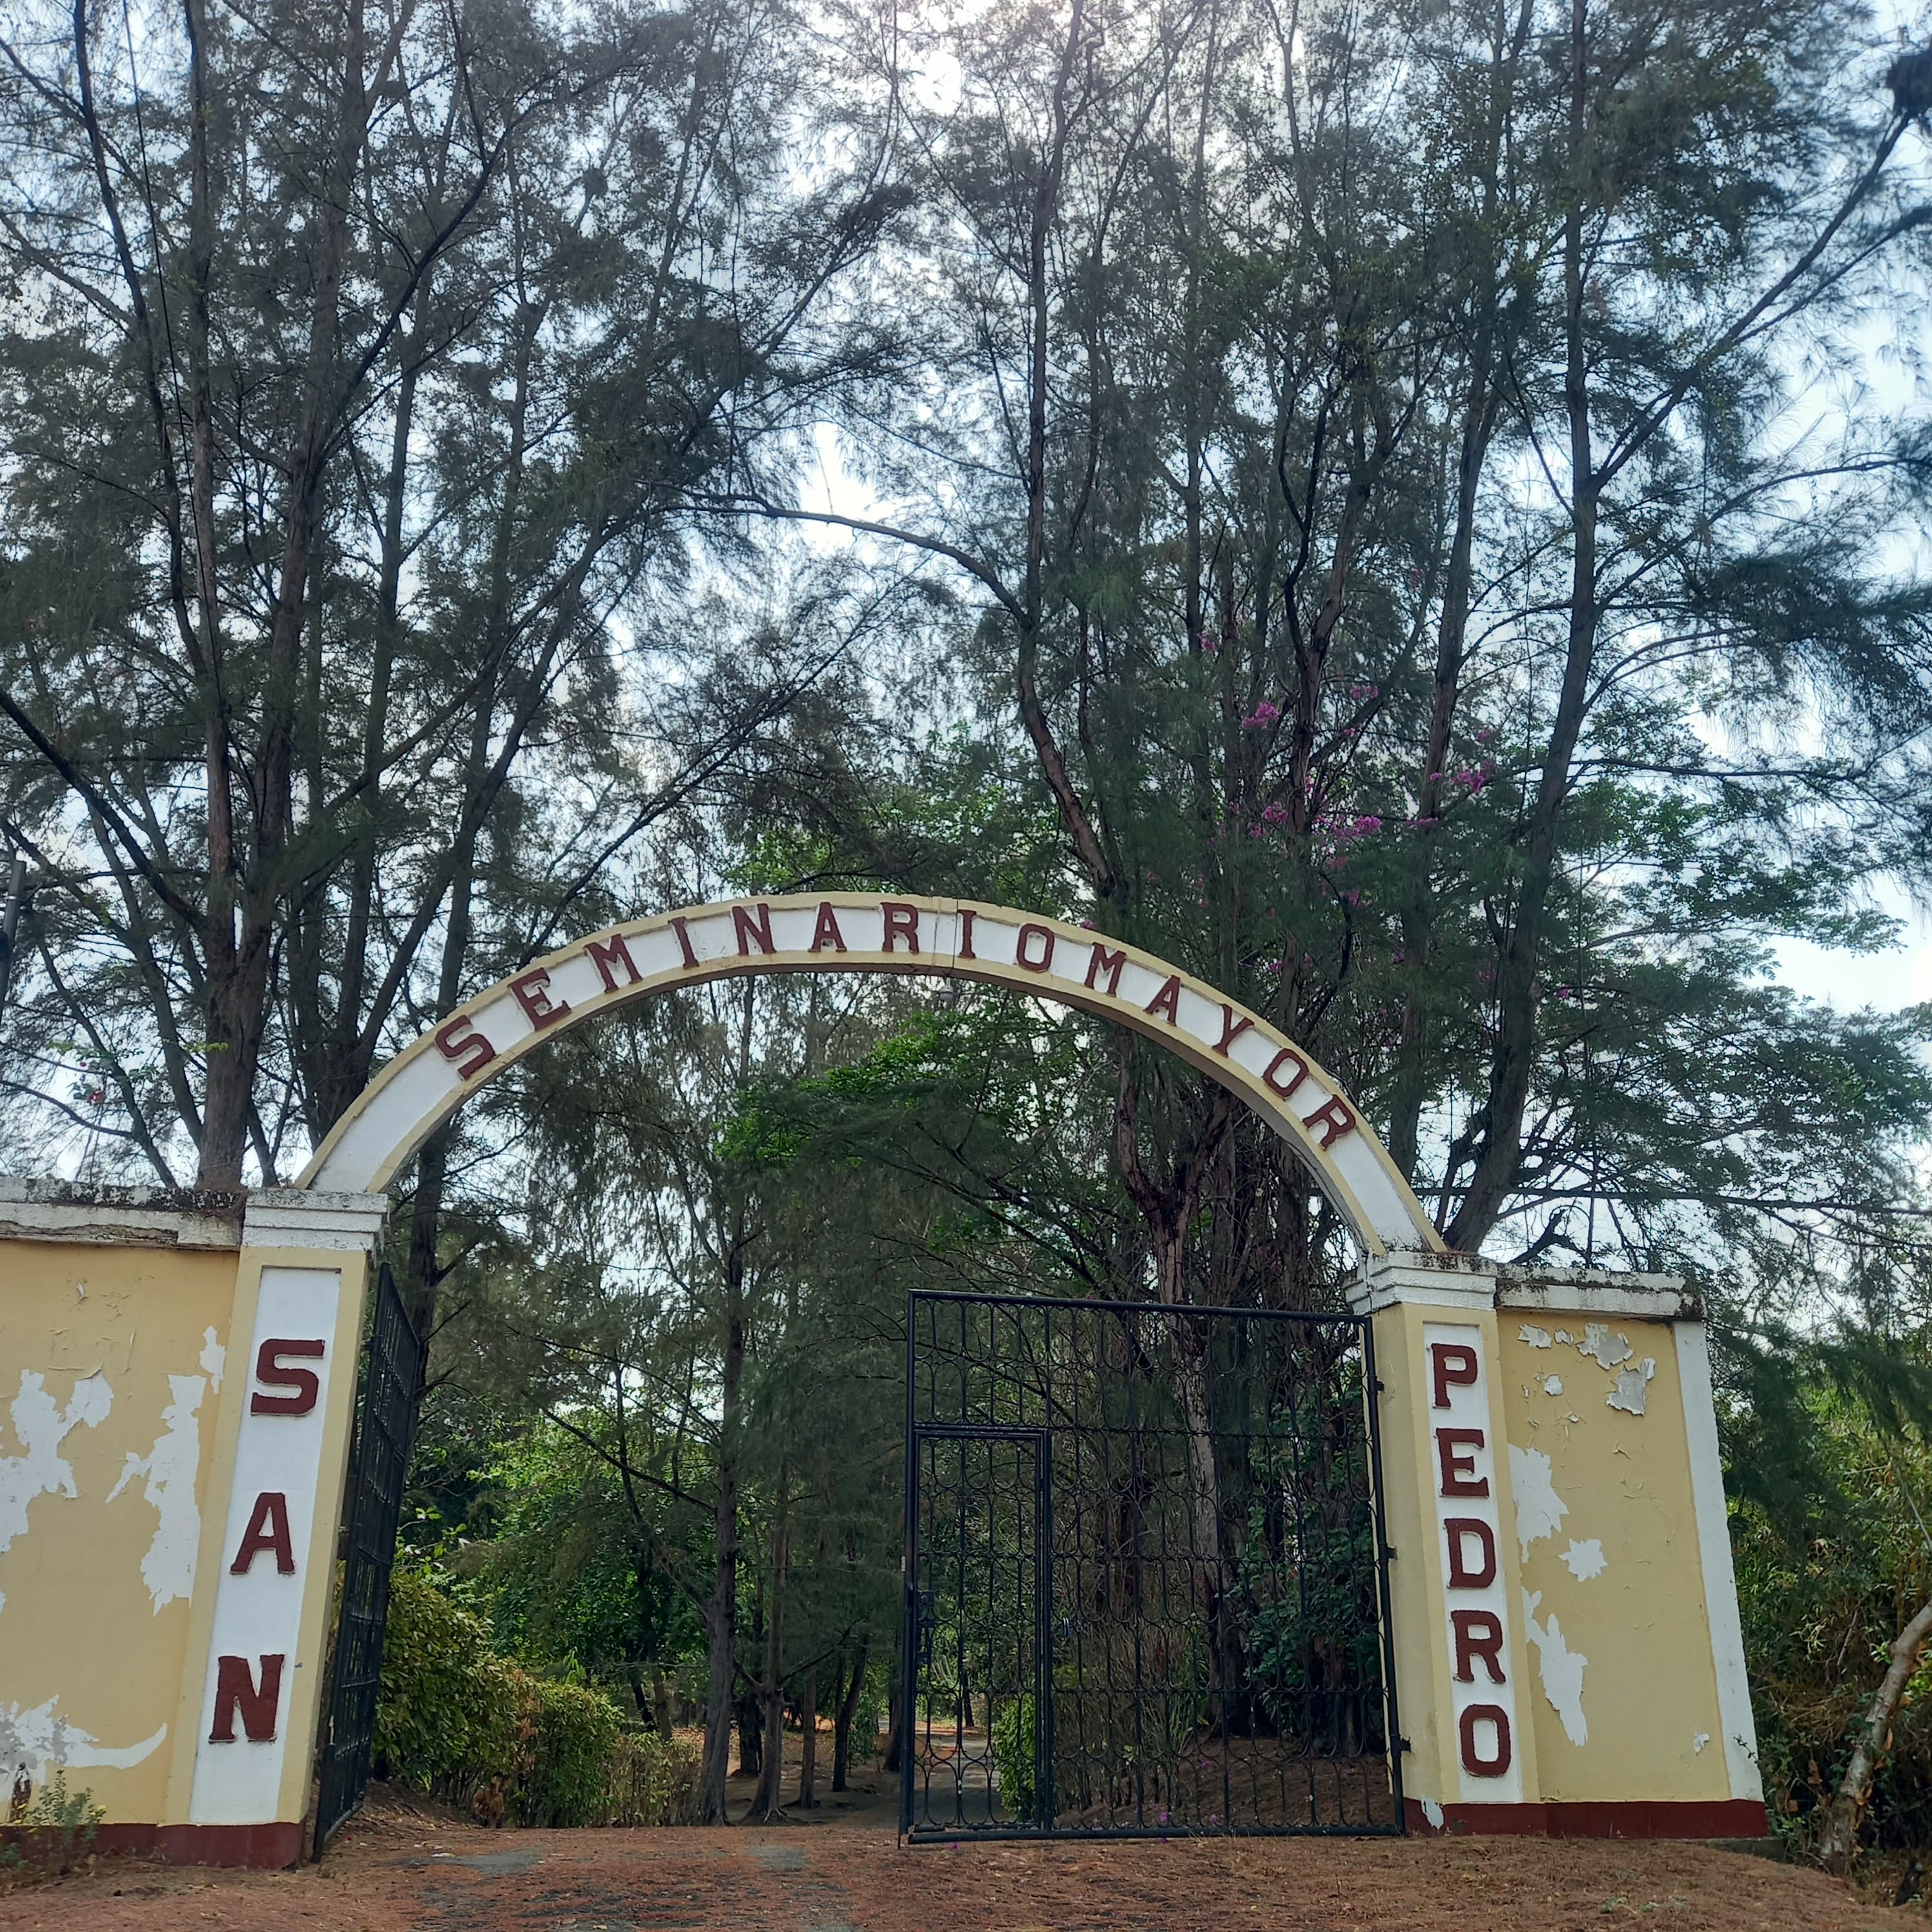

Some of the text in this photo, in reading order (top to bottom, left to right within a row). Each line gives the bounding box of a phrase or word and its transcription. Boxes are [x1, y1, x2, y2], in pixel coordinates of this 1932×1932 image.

[435, 901, 1355, 1150] SEMINARIO MAYOR
[209, 1339, 325, 1743] SAN
[1431, 1343, 1512, 1777] PEDRO
